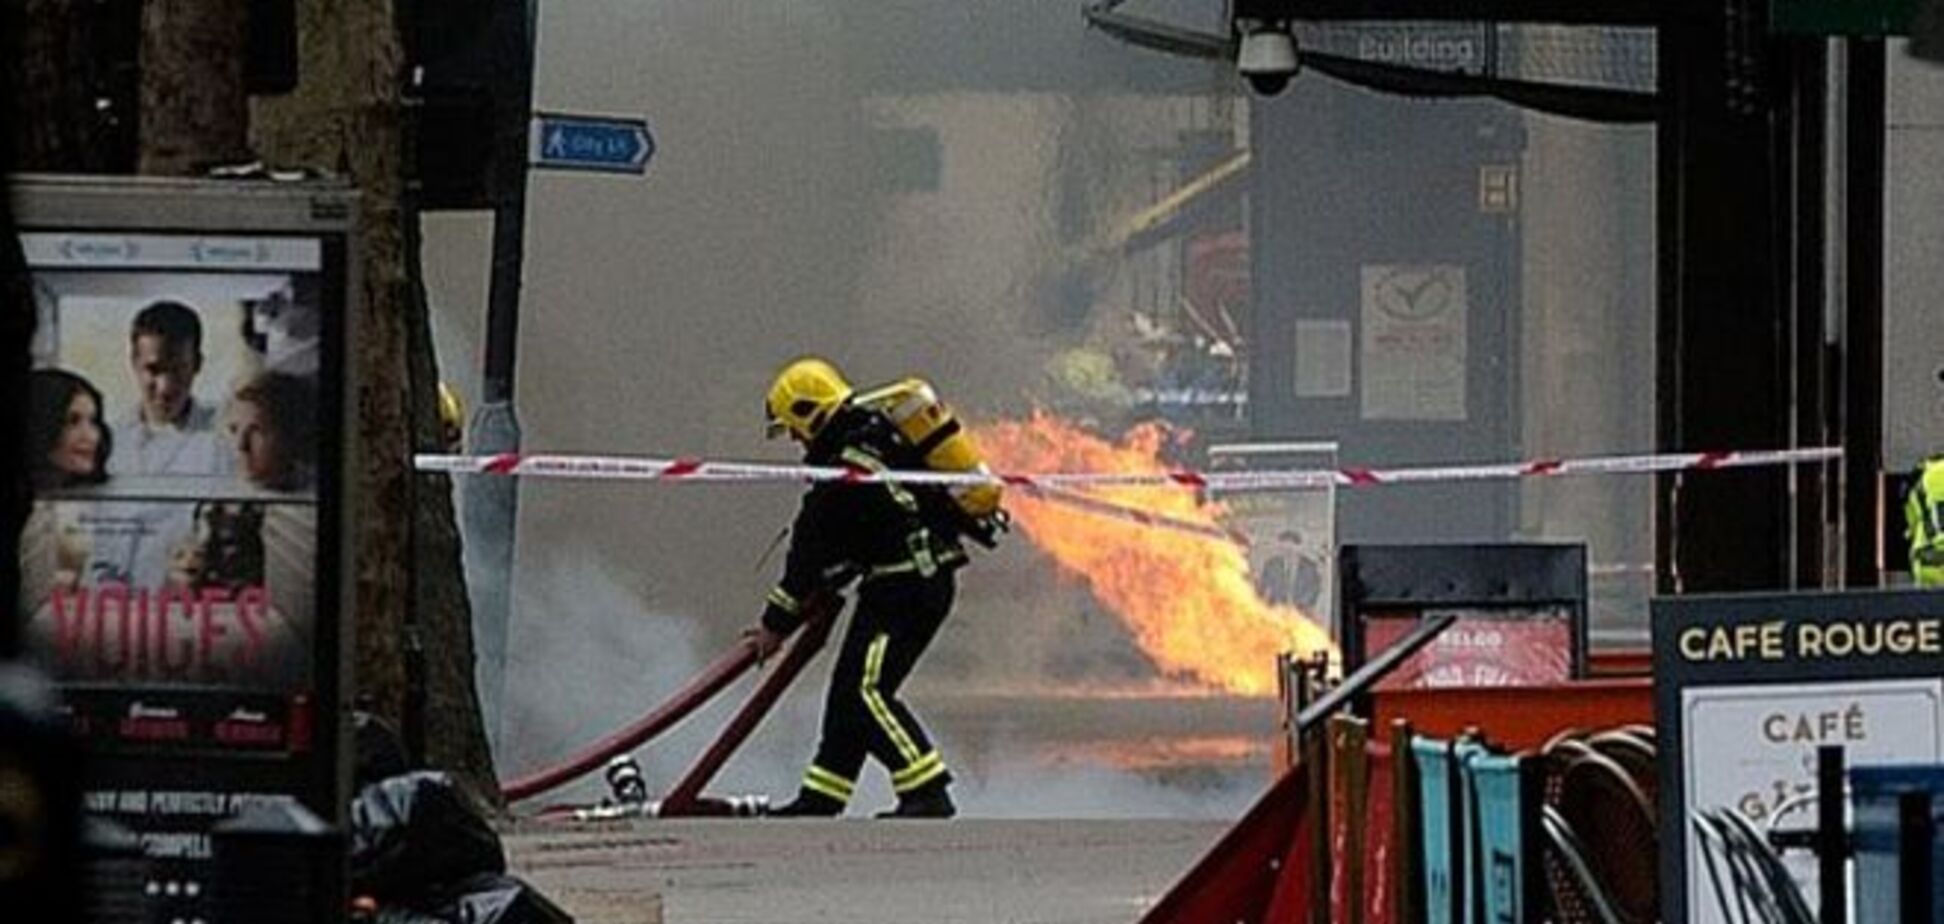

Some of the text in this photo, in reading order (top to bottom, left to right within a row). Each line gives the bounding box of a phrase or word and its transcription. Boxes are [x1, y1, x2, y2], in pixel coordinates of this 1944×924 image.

[1361, 32, 1474, 64] Building
[51, 587, 267, 668] VOICES
[1799, 620, 1941, 657] ROUGE
[1763, 703, 1867, 743] CAFÉ
